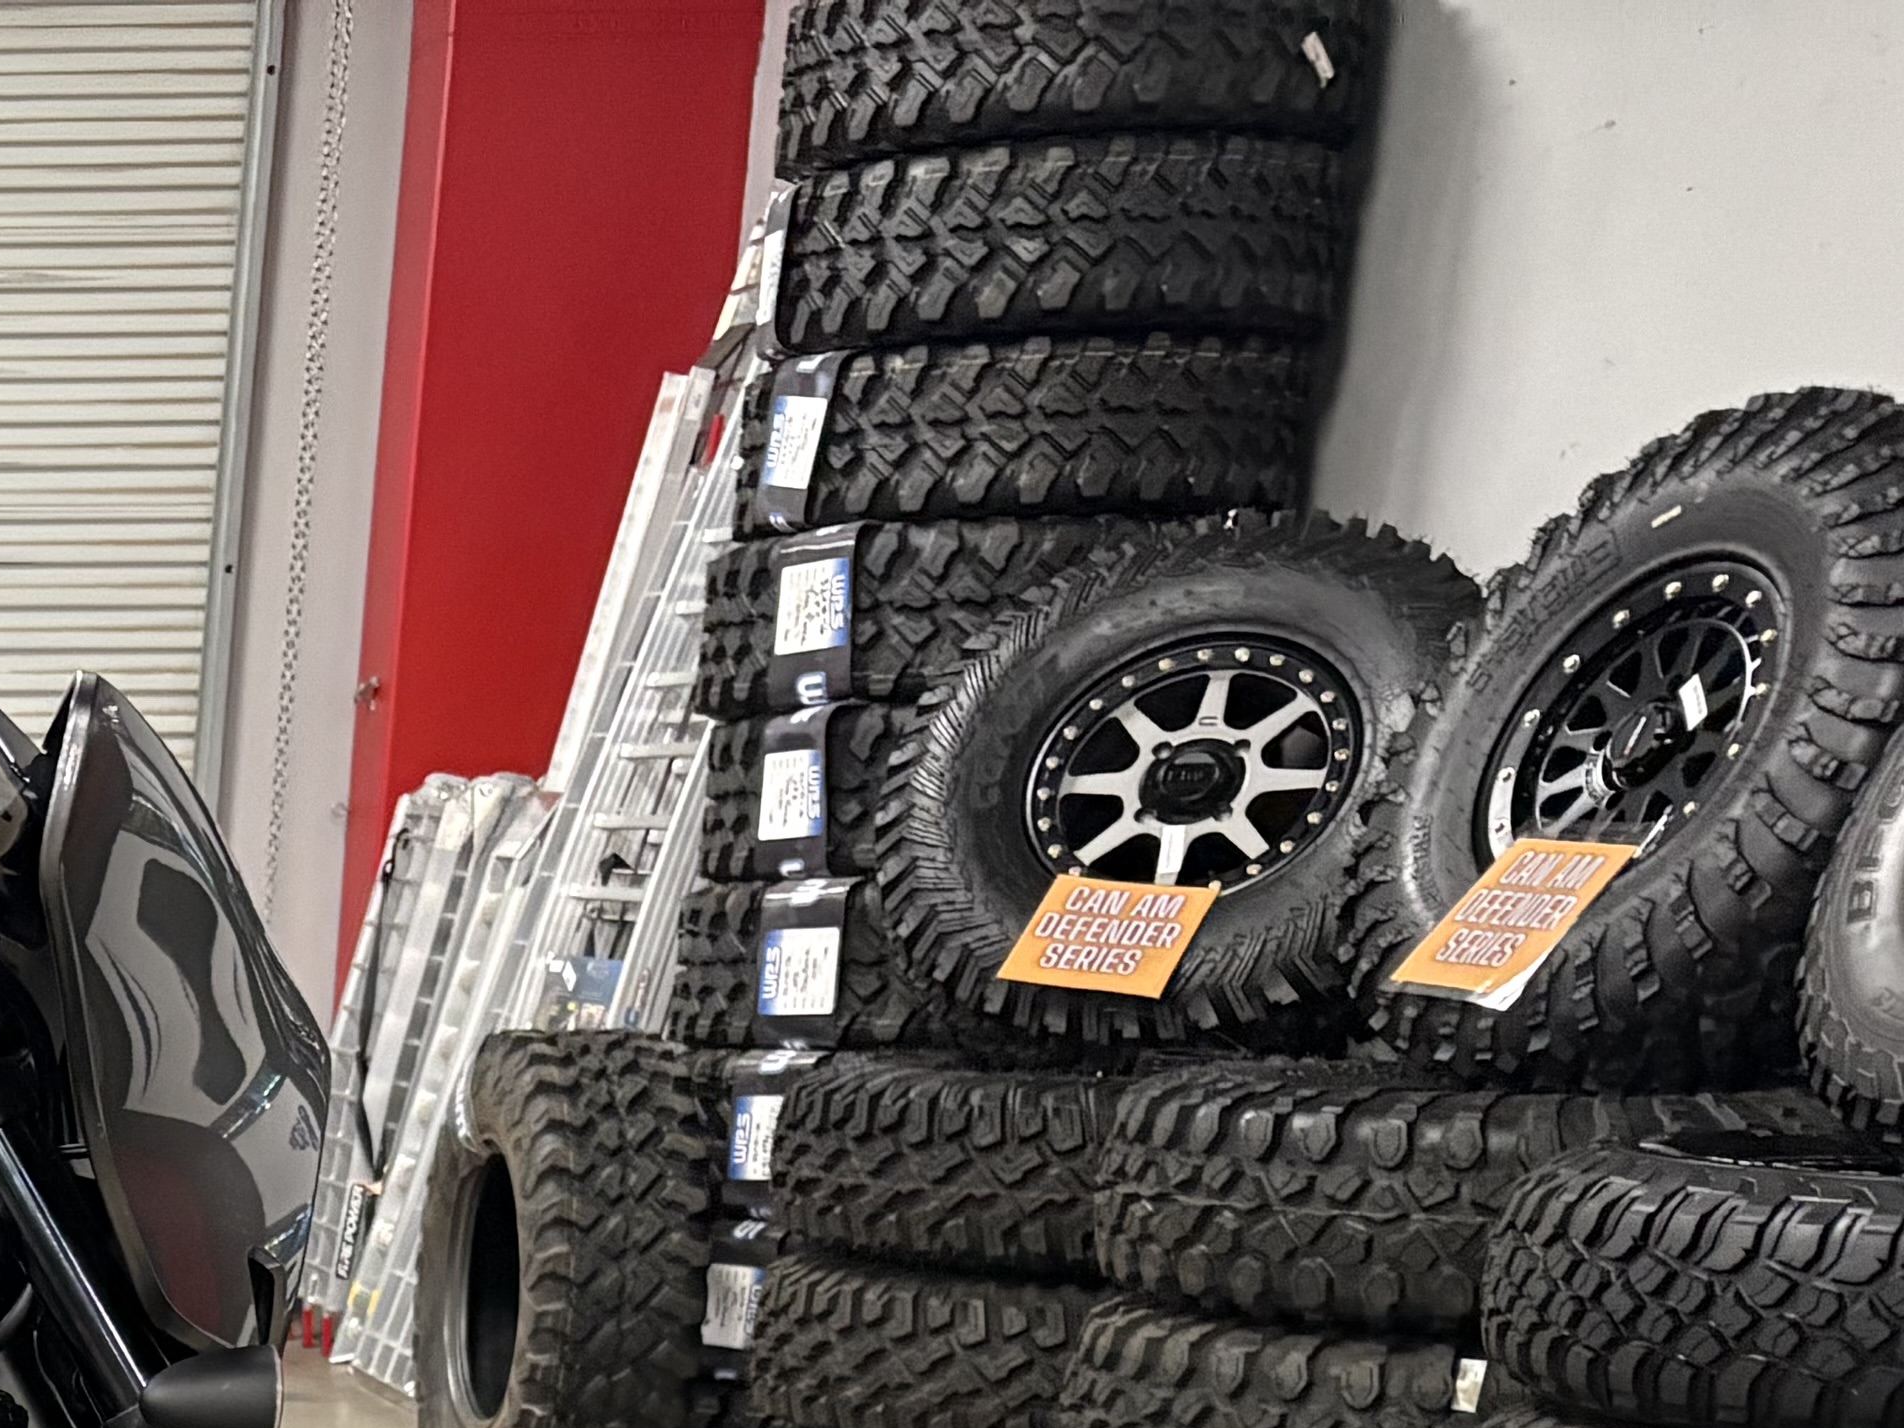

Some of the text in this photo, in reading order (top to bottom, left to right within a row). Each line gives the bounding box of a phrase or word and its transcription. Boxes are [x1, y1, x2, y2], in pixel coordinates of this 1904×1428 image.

[830, 574, 846, 631] WPS
[1499, 850, 1605, 890] CAN AM
[1065, 886, 1186, 919] CAN AM
[1454, 888, 1578, 930] DEFENDER
[1034, 911, 1182, 949] DEFENDER
[1435, 928, 1527, 967] SERIES
[762, 946, 782, 1000] WPS
[1039, 942, 1143, 976] SERIES
[733, 1112, 752, 1164] WPS
[343, 1184, 364, 1244] POWER
